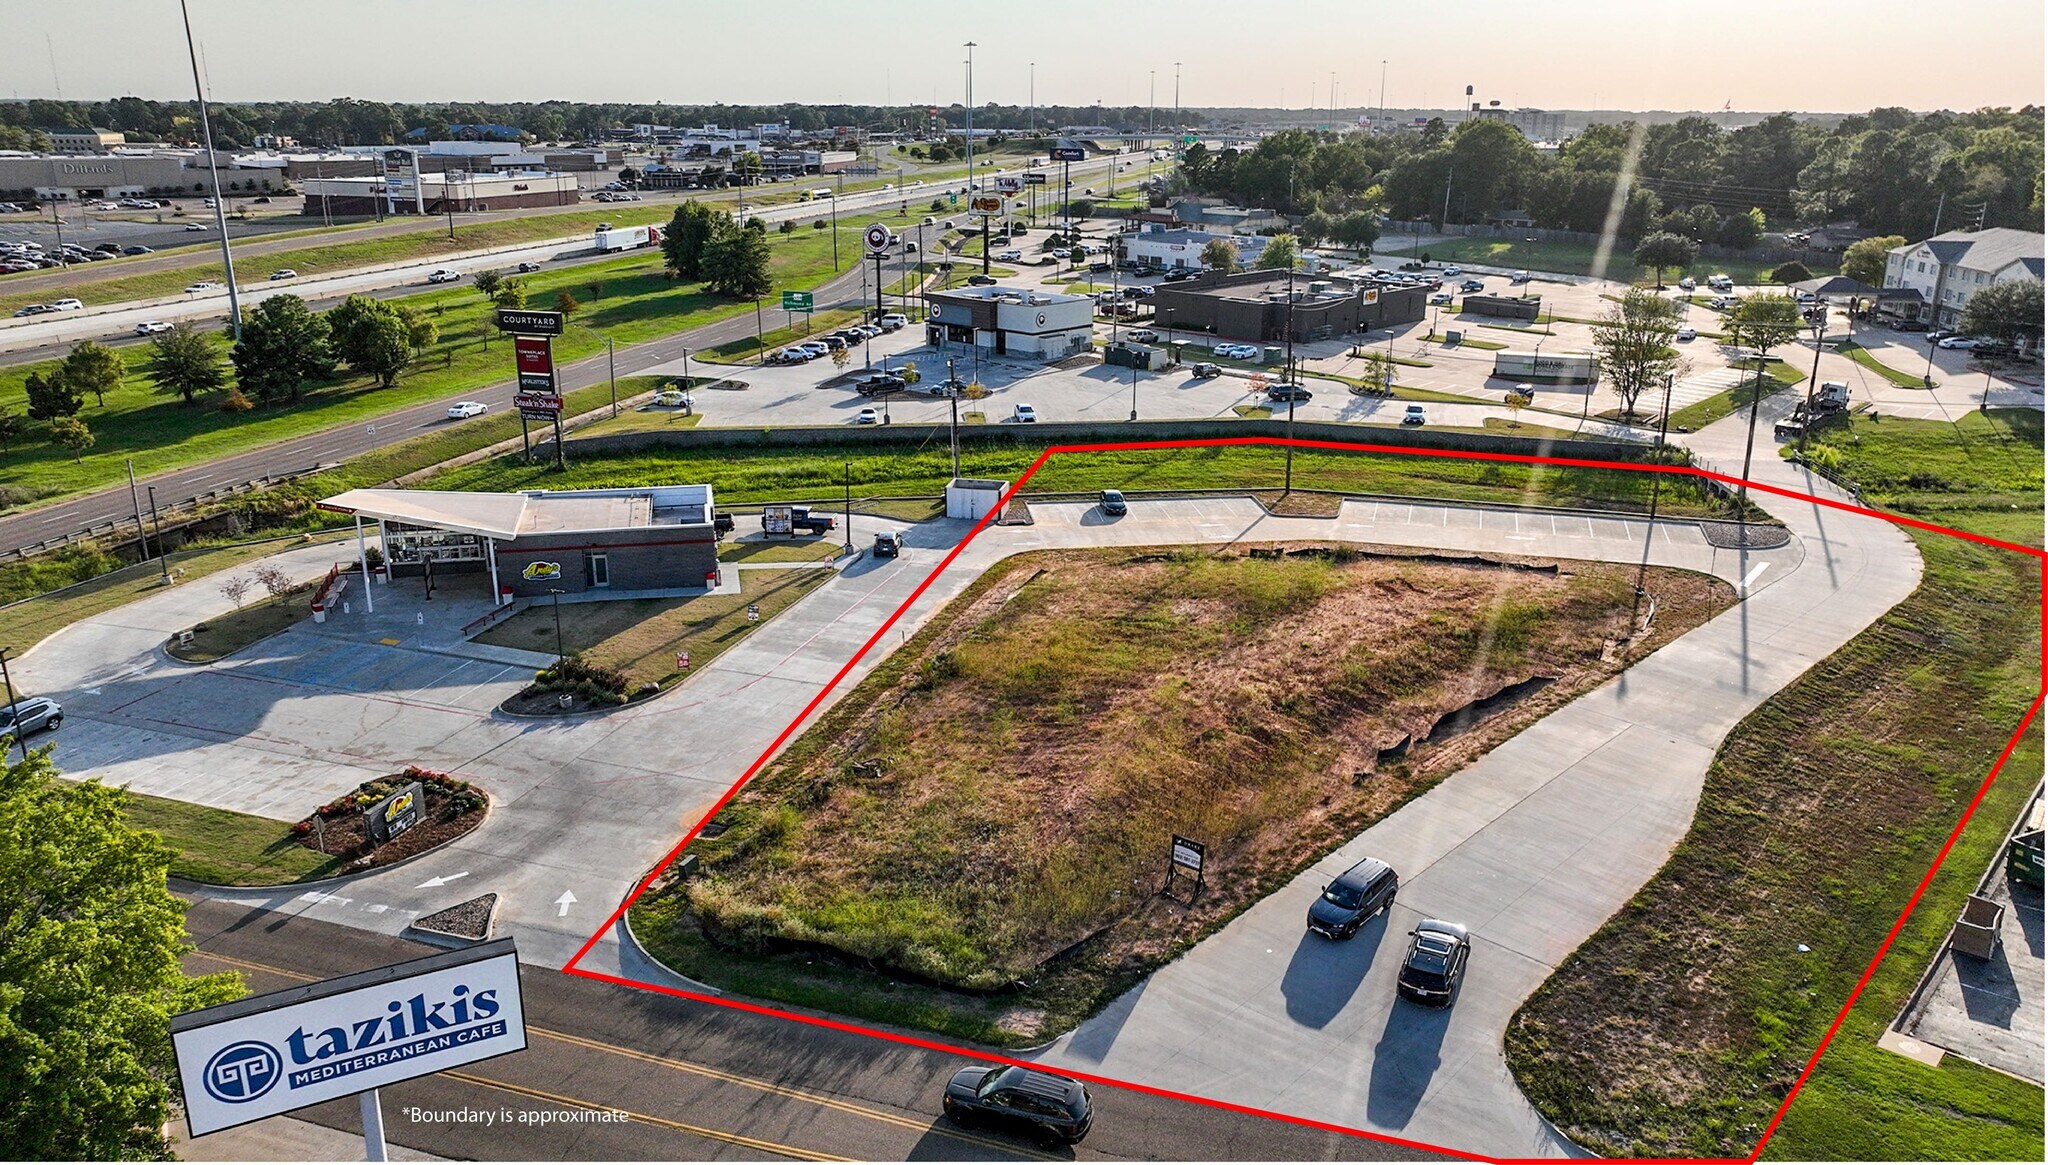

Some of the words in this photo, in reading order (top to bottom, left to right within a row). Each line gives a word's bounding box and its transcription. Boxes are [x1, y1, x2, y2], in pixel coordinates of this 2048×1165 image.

[503, 316, 555, 325] COURTYARD
[538, 399, 559, 409] Shake
[285, 984, 500, 1065] tazikis
[295, 1035, 451, 1085] MEDITERRANEAN
[456, 1023, 503, 1043] CAFE
